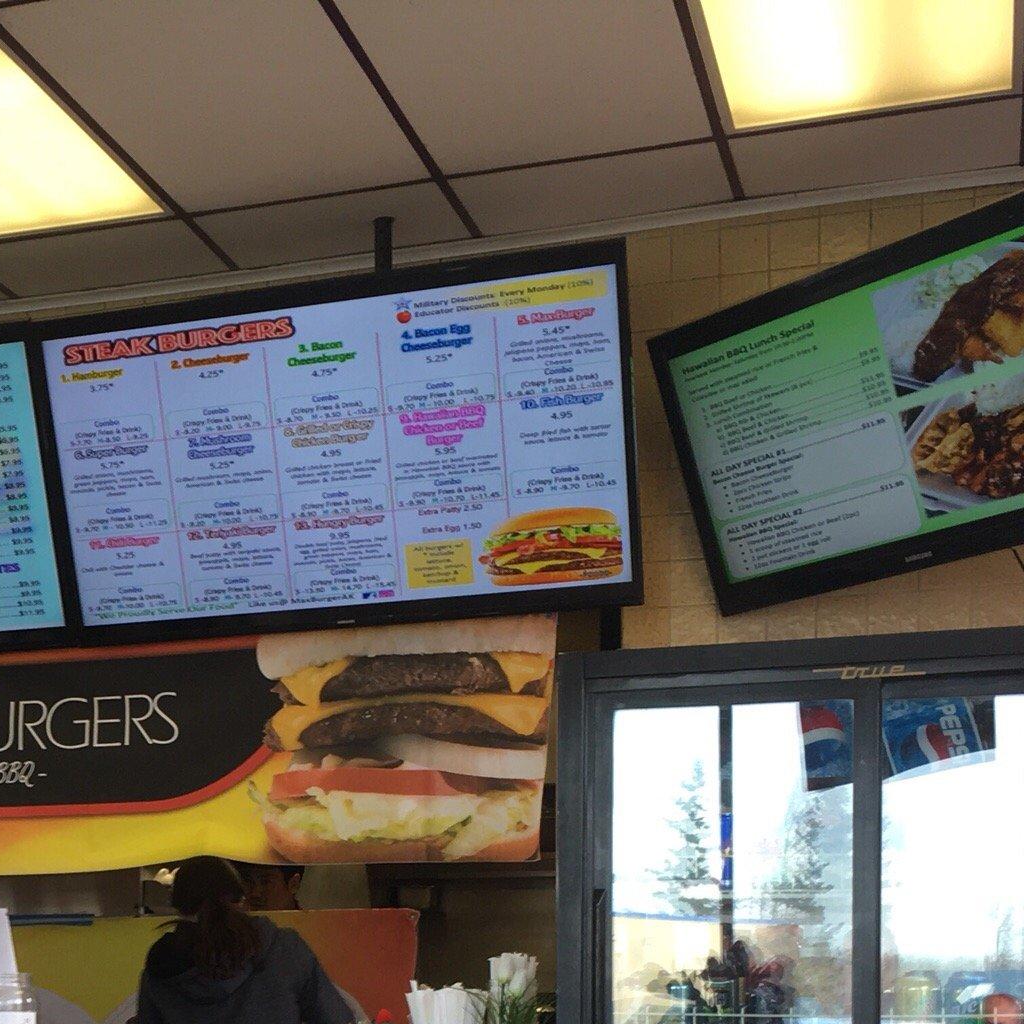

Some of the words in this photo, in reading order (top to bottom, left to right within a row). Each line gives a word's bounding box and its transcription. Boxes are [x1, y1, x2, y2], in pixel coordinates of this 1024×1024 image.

[414, 299, 448, 310] Military
[499, 287, 525, 299] Every
[527, 281, 565, 295] Monday
[414, 308, 455, 320] Educator
[457, 300, 500, 313] Discounts
[414, 326, 448, 340] Bacon
[449, 322, 472, 337] Egg
[779, 320, 816, 343] Special
[65, 336, 154, 366] STEAK
[157, 316, 295, 355] BURGERS
[311, 340, 344, 353] Bacon
[400, 337, 474, 354] Cheeseburger
[183, 353, 251, 369] Cheeseburger
[286, 351, 358, 368] Cheeseburger
[72, 368, 123, 381] Hamburger
[544, 365, 574, 375] Combo
[425, 380, 454, 390] Combo
[311, 393, 339, 403] Combo
[549, 410, 573, 421] 4.95
[550, 464, 580, 475] Combo
[711, 467, 725, 478] ALL
[742, 452, 776, 472] SPECIAL
[433, 476, 462, 487] Combo
[727, 526, 741, 537] ALL
[759, 511, 793, 530] SPECIAL
[934, 703, 970, 759] PEPS
